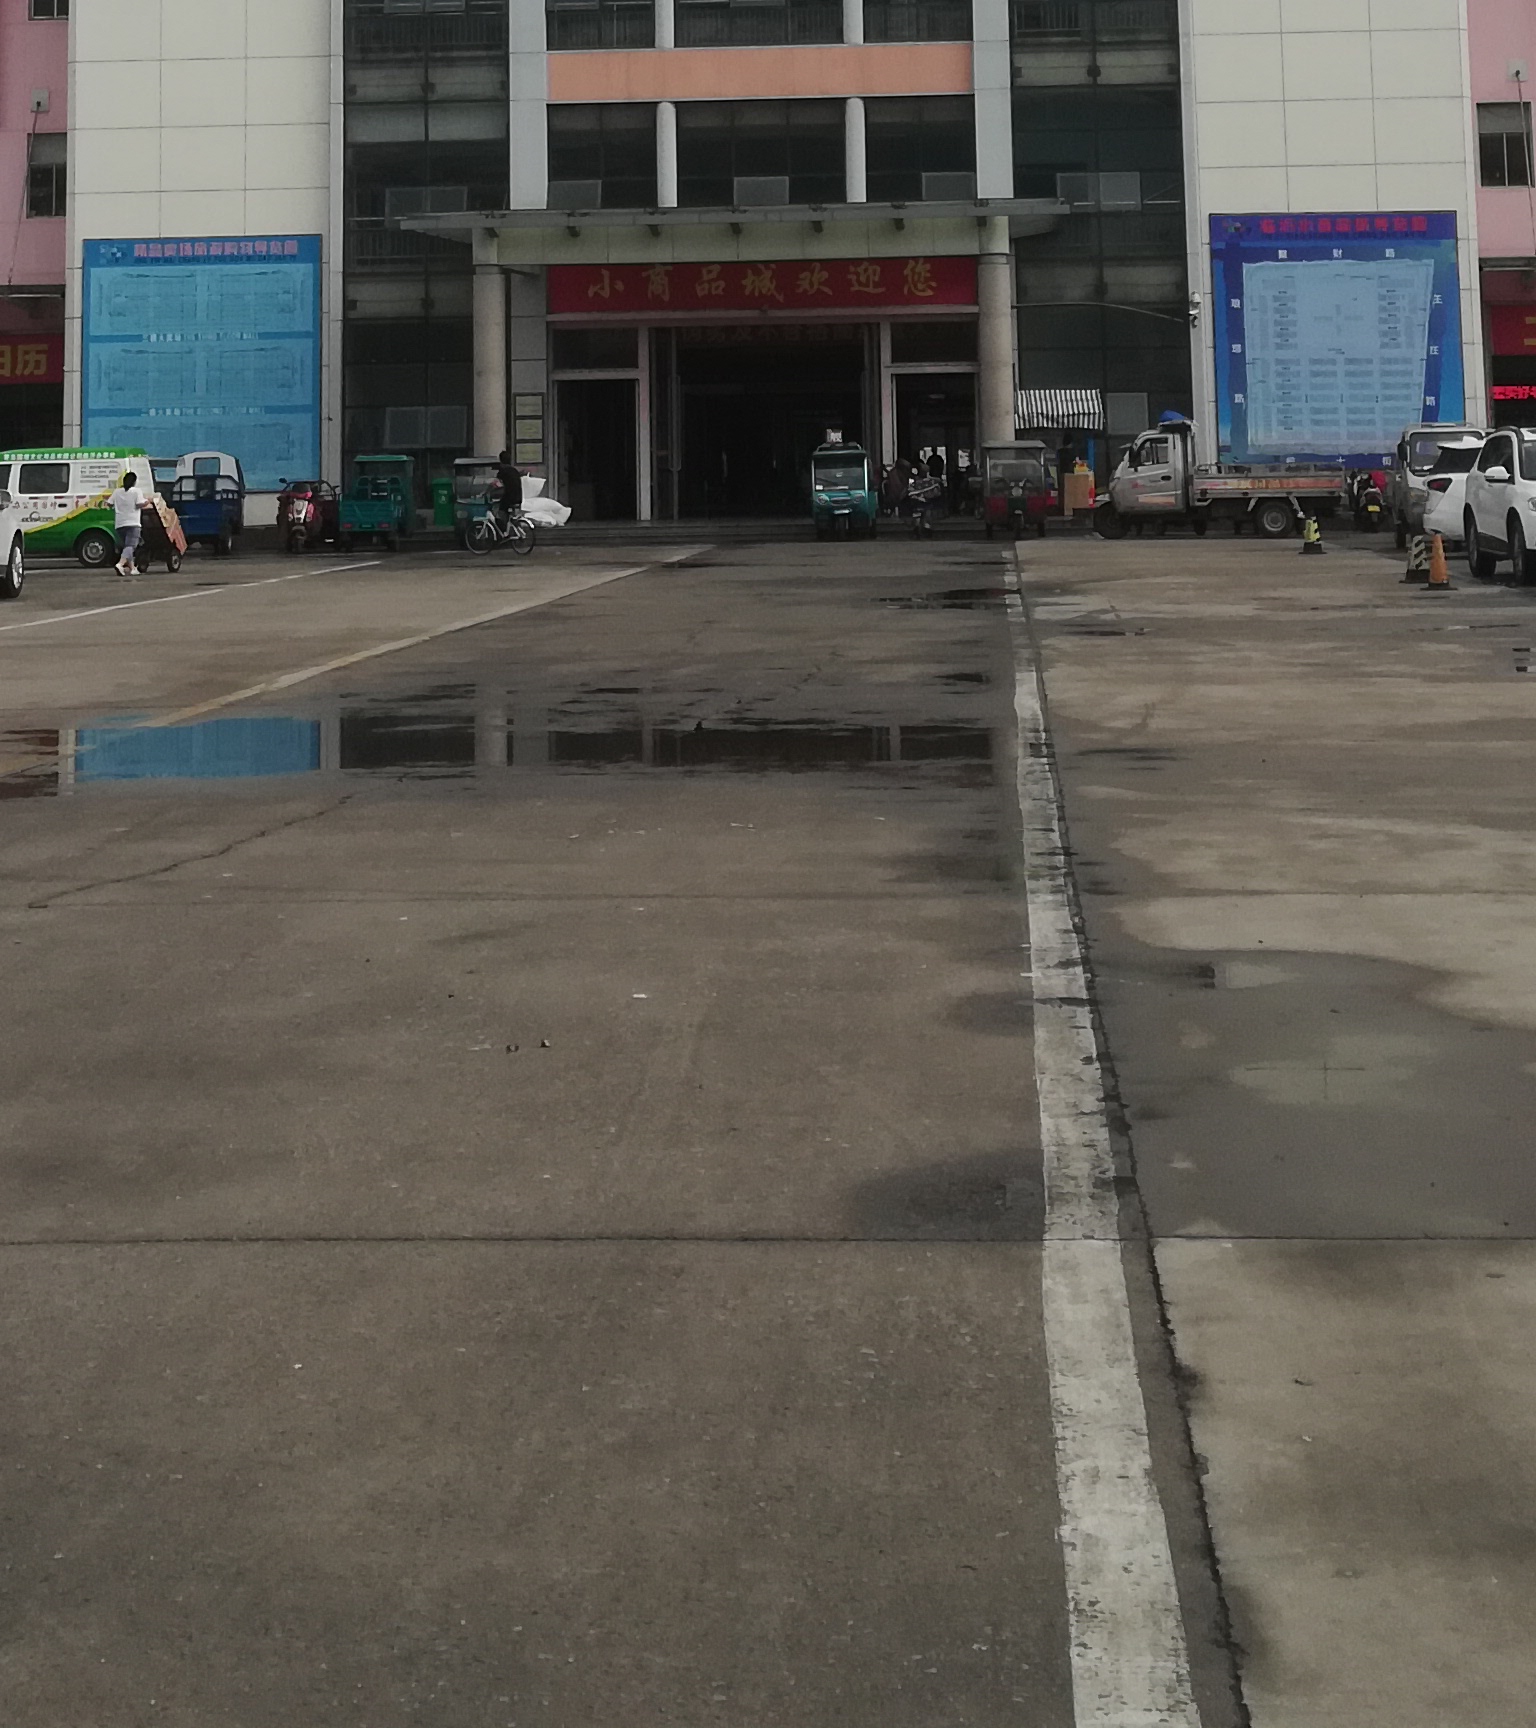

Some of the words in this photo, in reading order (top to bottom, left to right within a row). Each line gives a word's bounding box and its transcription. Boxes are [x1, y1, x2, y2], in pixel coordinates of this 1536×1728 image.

[587, 259, 937, 303] 小商品城欢迎您
